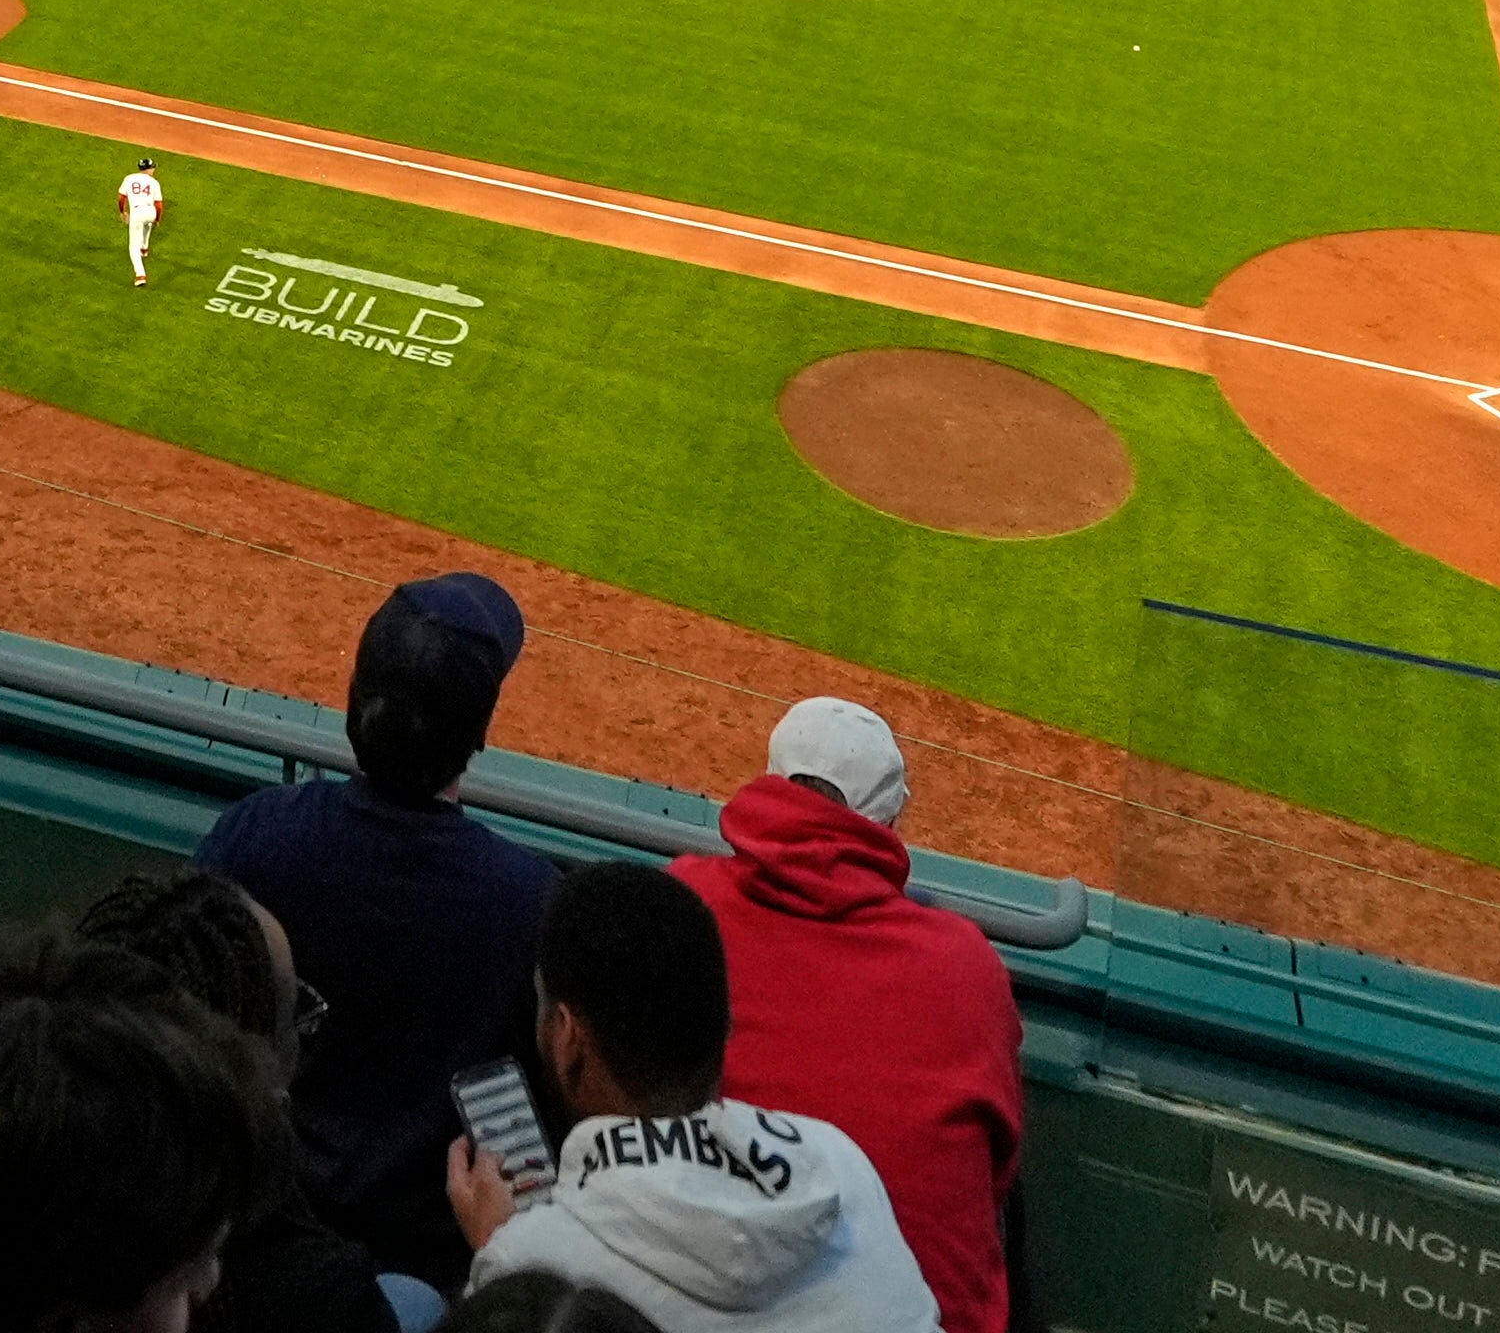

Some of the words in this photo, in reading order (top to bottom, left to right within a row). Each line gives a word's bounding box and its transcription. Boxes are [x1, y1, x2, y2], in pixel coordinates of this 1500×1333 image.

[130, 180, 152, 198] 84
[203, 296, 455, 370] SUBMARINES
[215, 264, 470, 347] BUILD
[1227, 1169, 1467, 1270] WARNING:
[1251, 1235, 1388, 1299] WATCH
[1402, 1284, 1493, 1328] OUT
